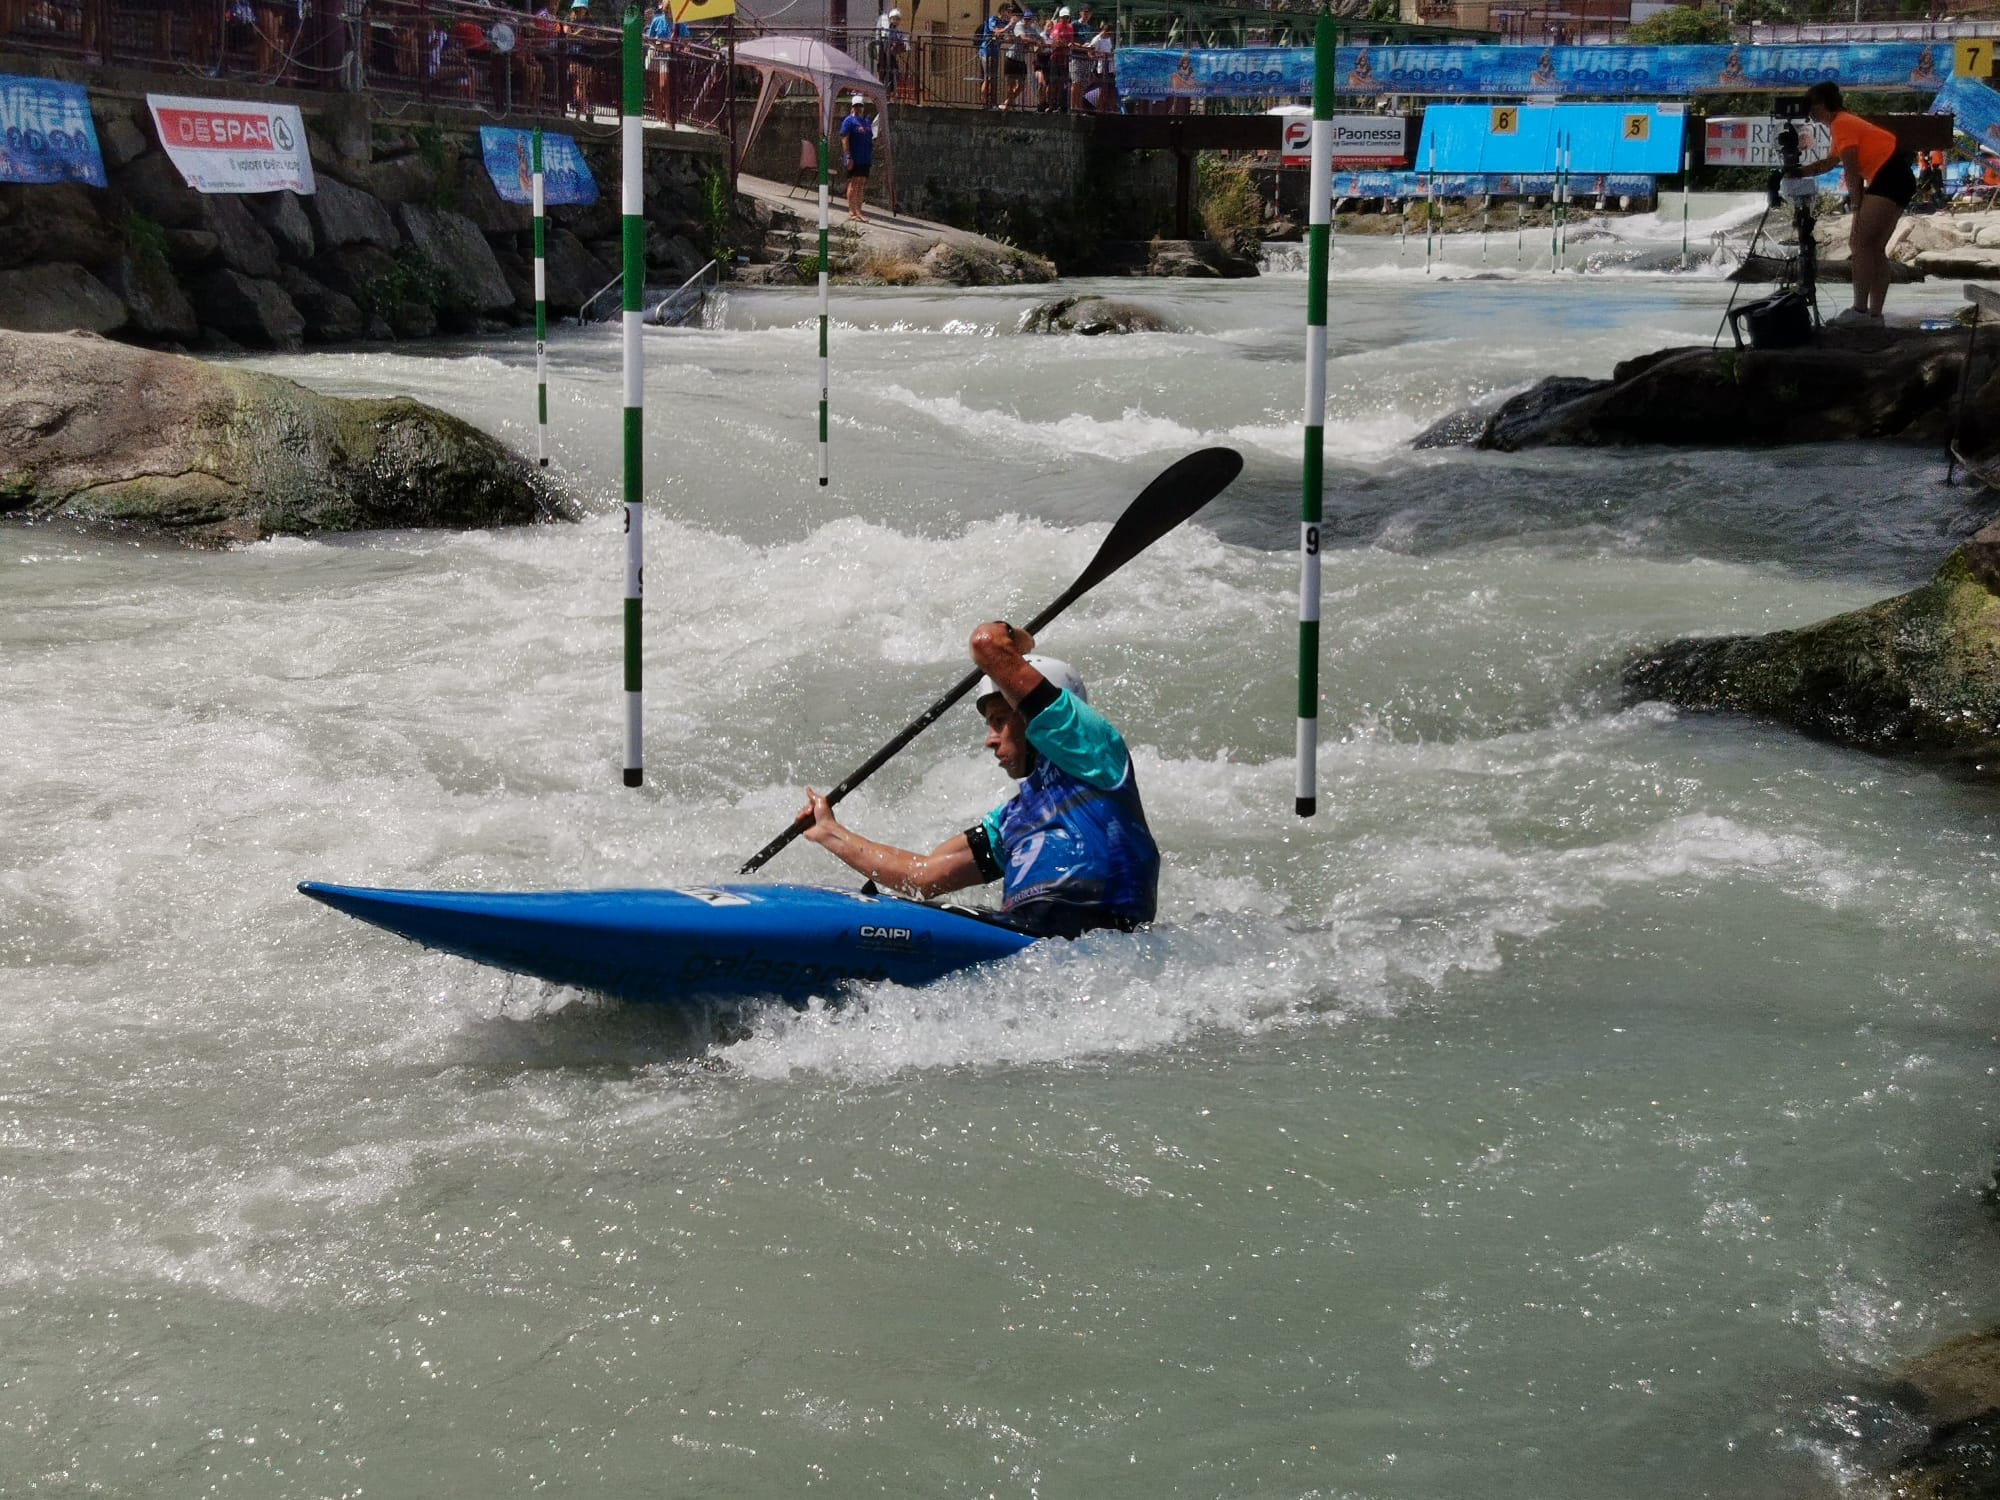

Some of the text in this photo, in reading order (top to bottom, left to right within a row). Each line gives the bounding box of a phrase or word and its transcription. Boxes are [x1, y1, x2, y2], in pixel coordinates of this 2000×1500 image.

[1199, 53, 1284, 74] IVREA
[1377, 50, 1463, 71] IVREA
[1560, 50, 1649, 71] IVREA
[1749, 49, 1840, 71] IVREA
[1967, 47, 1980, 71] 7
[1213, 72, 1282, 83] 2022
[1392, 69, 1462, 81] 2022
[1575, 70, 1648, 81] 2022
[1765, 69, 1839, 80] 2022
[1500, 112, 1508, 129] 6
[1631, 119, 1640, 135] 5
[178, 116, 273, 145] DESPAR
[537, 343, 543, 355] 8
[1306, 526, 1320, 556] 9
[860, 925, 912, 942] CAIPI
